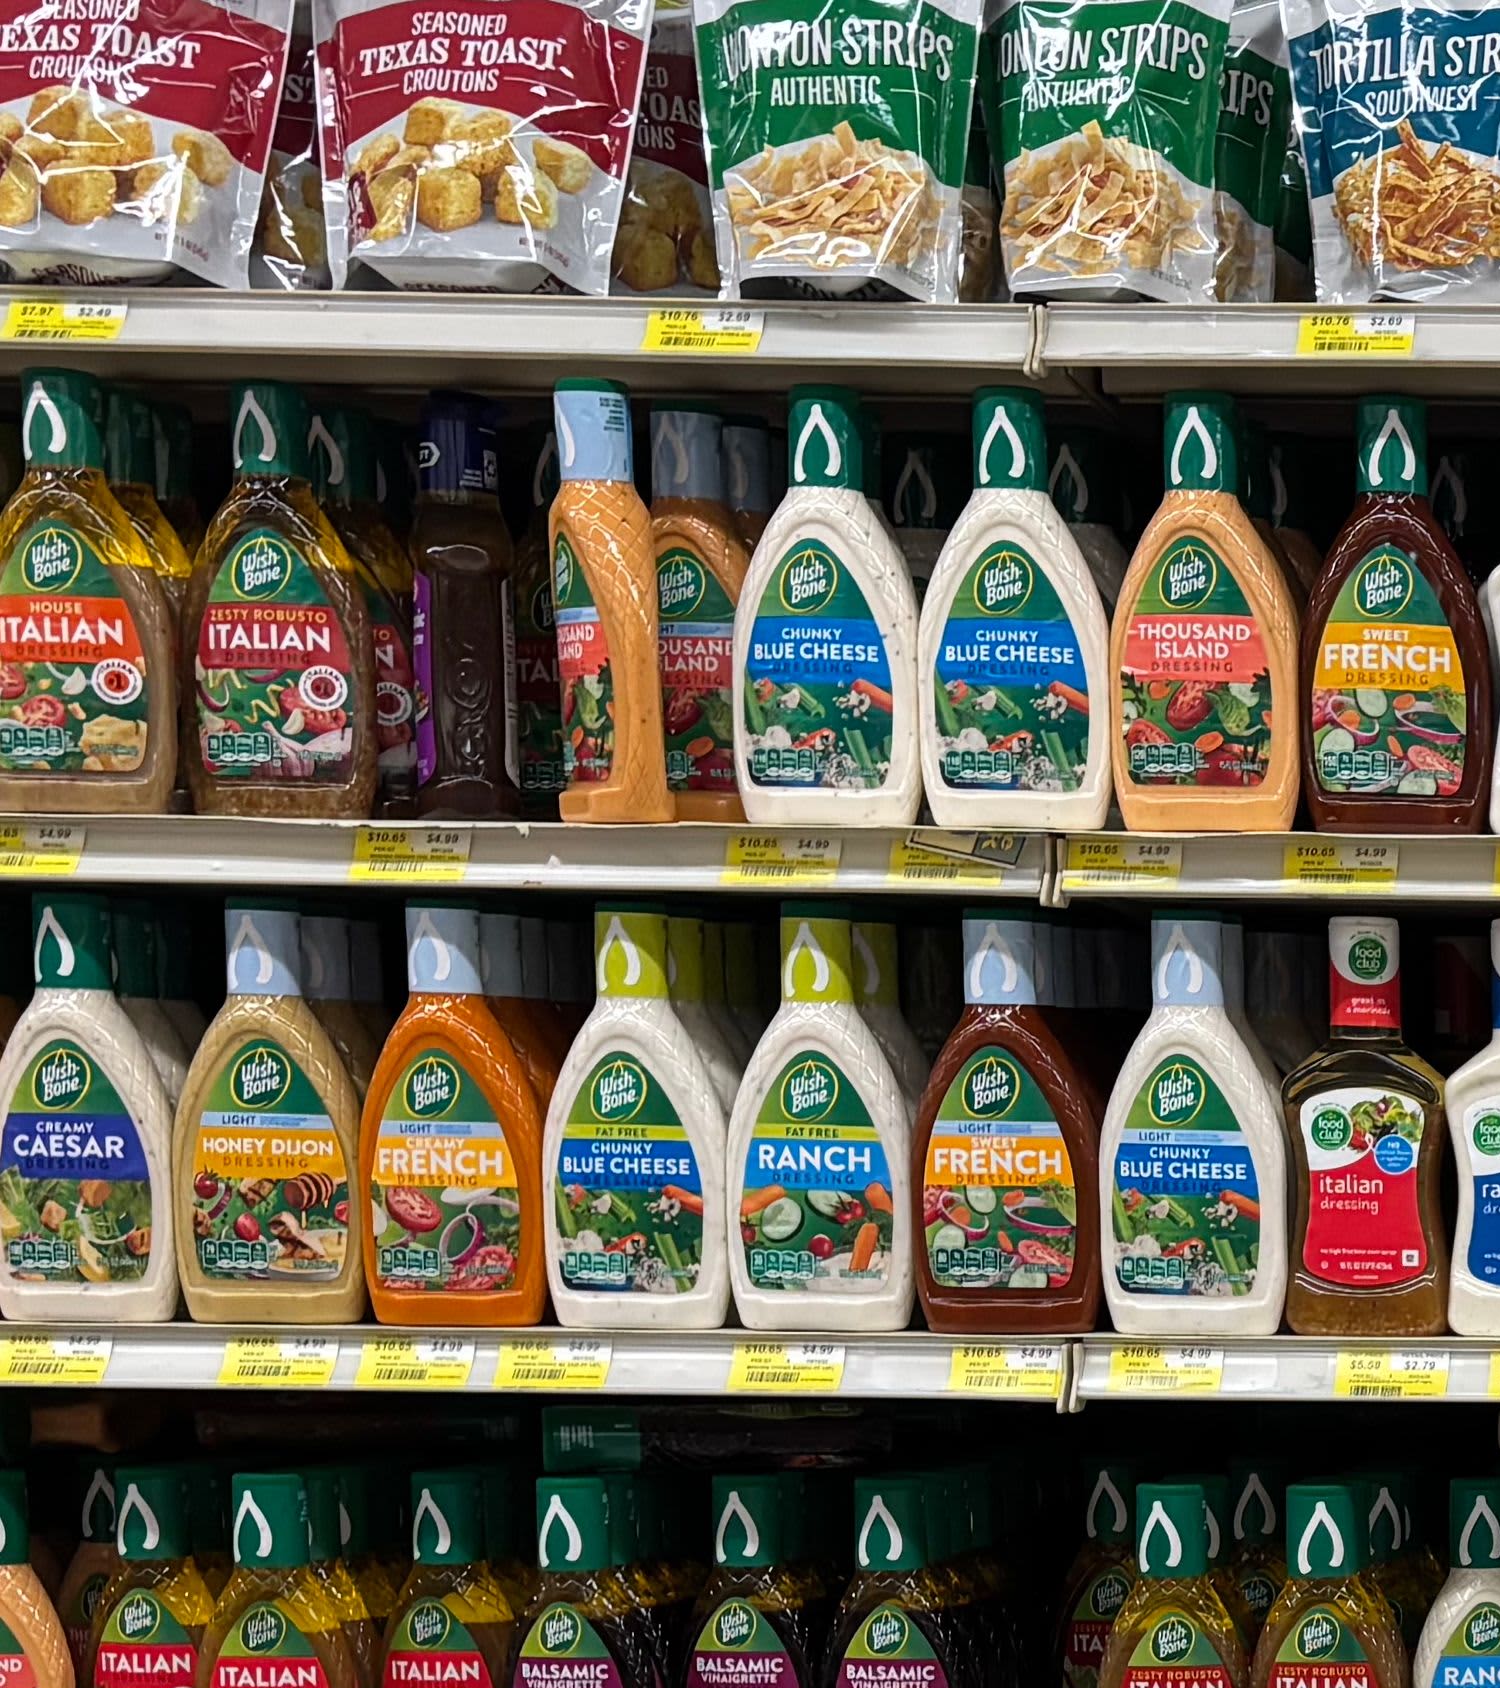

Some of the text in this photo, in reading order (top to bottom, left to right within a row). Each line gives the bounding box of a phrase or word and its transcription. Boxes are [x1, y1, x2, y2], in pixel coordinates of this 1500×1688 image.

[411, 12, 507, 36] SEASONED
[359, 37, 564, 77] TEXAS TOAST
[1309, 40, 1438, 96] TORTILLA
[402, 69, 500, 95] CROUTONS
[1365, 83, 1478, 116] SOUTHWEST
[21, 305, 54, 317] $7.97
[1311, 316, 1350, 328] $10.76
[1370, 316, 1404, 328] $2.69
[210, 609, 328, 624] ZESTY ROBUSTO
[207, 624, 331, 652] ITALIAN
[781, 627, 842, 640] CHUNKY
[1137, 624, 1250, 642] THOUSAND
[1362, 629, 1410, 642] SWEET
[753, 642, 880, 663] BLUE CHEESE
[1154, 641, 1229, 660] ISLAND
[1323, 643, 1451, 671] FRENCH
[36, 1121, 94, 1134] CREAMY
[595, 1125, 647, 1137] FAT FREE
[13, 1134, 125, 1159] CAESAR
[202, 1137, 334, 1156] HONEY DIJON
[759, 1146, 872, 1172] RANCH
[1318, 1173, 1384, 1194] italian
[521, 1663, 609, 1682] BALSAMIC
